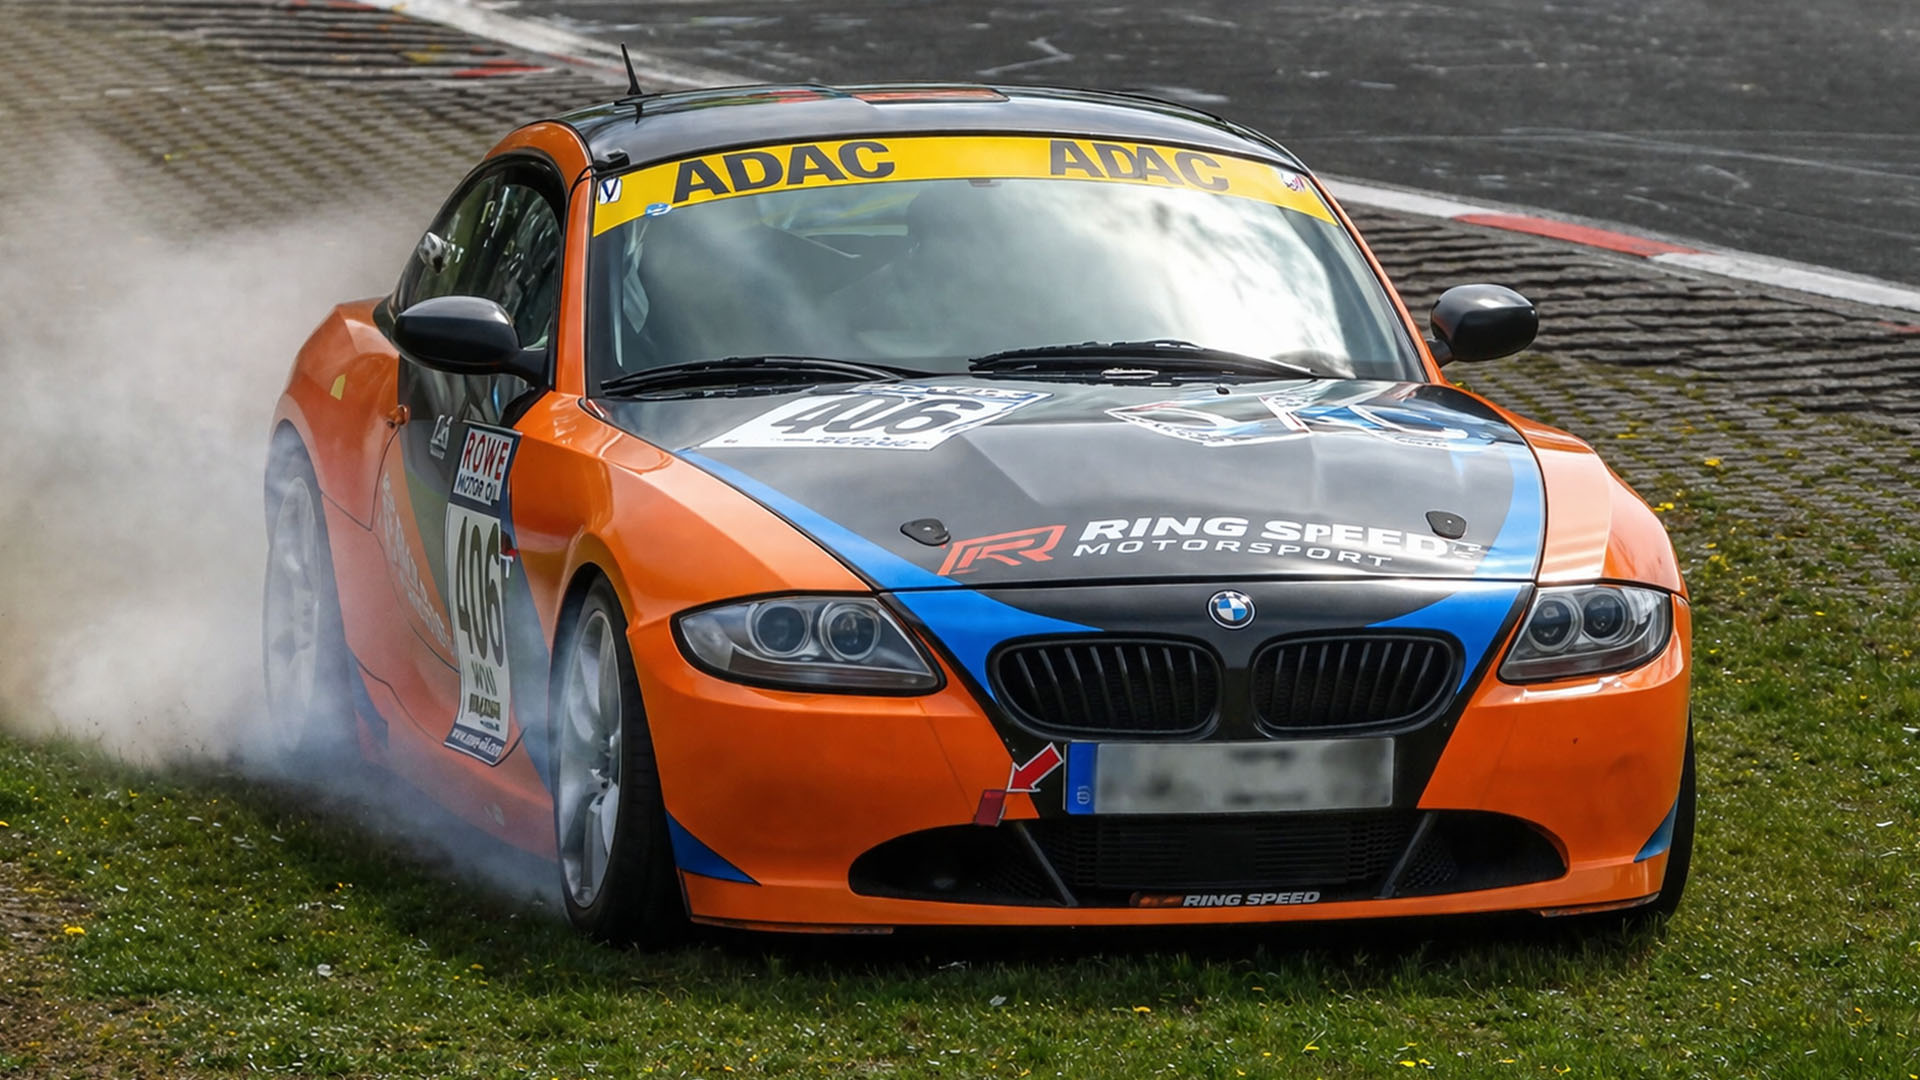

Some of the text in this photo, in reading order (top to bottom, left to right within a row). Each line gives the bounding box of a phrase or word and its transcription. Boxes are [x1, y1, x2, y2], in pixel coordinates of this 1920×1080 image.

[672, 141, 895, 204] ADAC
[1050, 139, 1230, 192] ADAC
[770, 395, 985, 434] 406
[462, 431, 510, 481] ROWE
[457, 473, 484, 497] MOTOR
[1072, 539, 1393, 567] MOTORSPORT
[1079, 517, 1249, 541] RING
[1261, 520, 1448, 557] SPEED
[456, 515, 504, 668] 406
[1183, 894, 1242, 907] RING
[1245, 891, 1321, 905] SPEED
